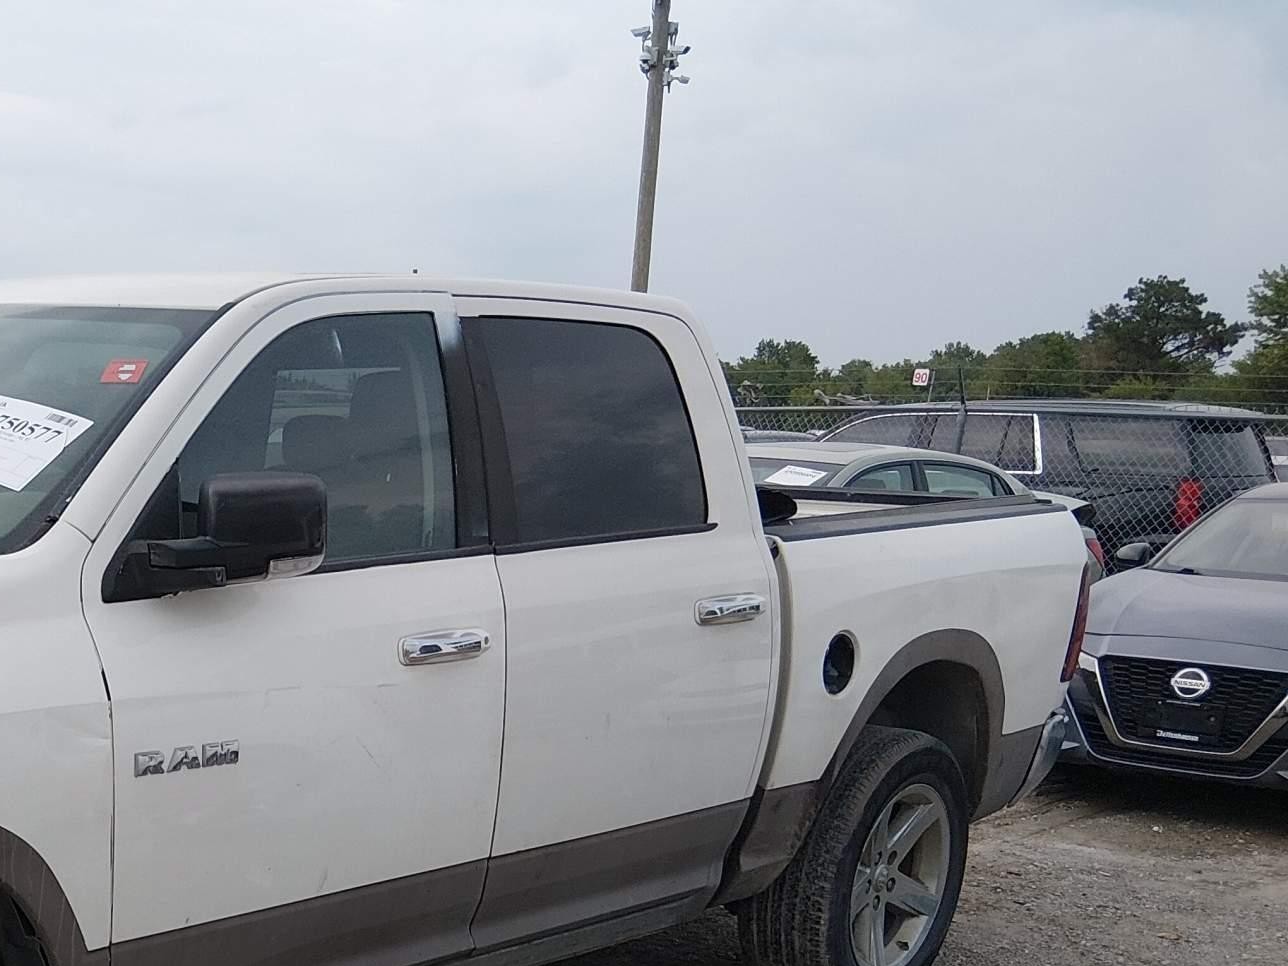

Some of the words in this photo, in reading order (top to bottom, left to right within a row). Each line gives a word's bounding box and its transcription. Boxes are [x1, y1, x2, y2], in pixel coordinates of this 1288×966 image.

[914, 372, 928, 384] 90
[1173, 679, 1206, 689] NISSAN
[134, 739, 240, 778] RAM
